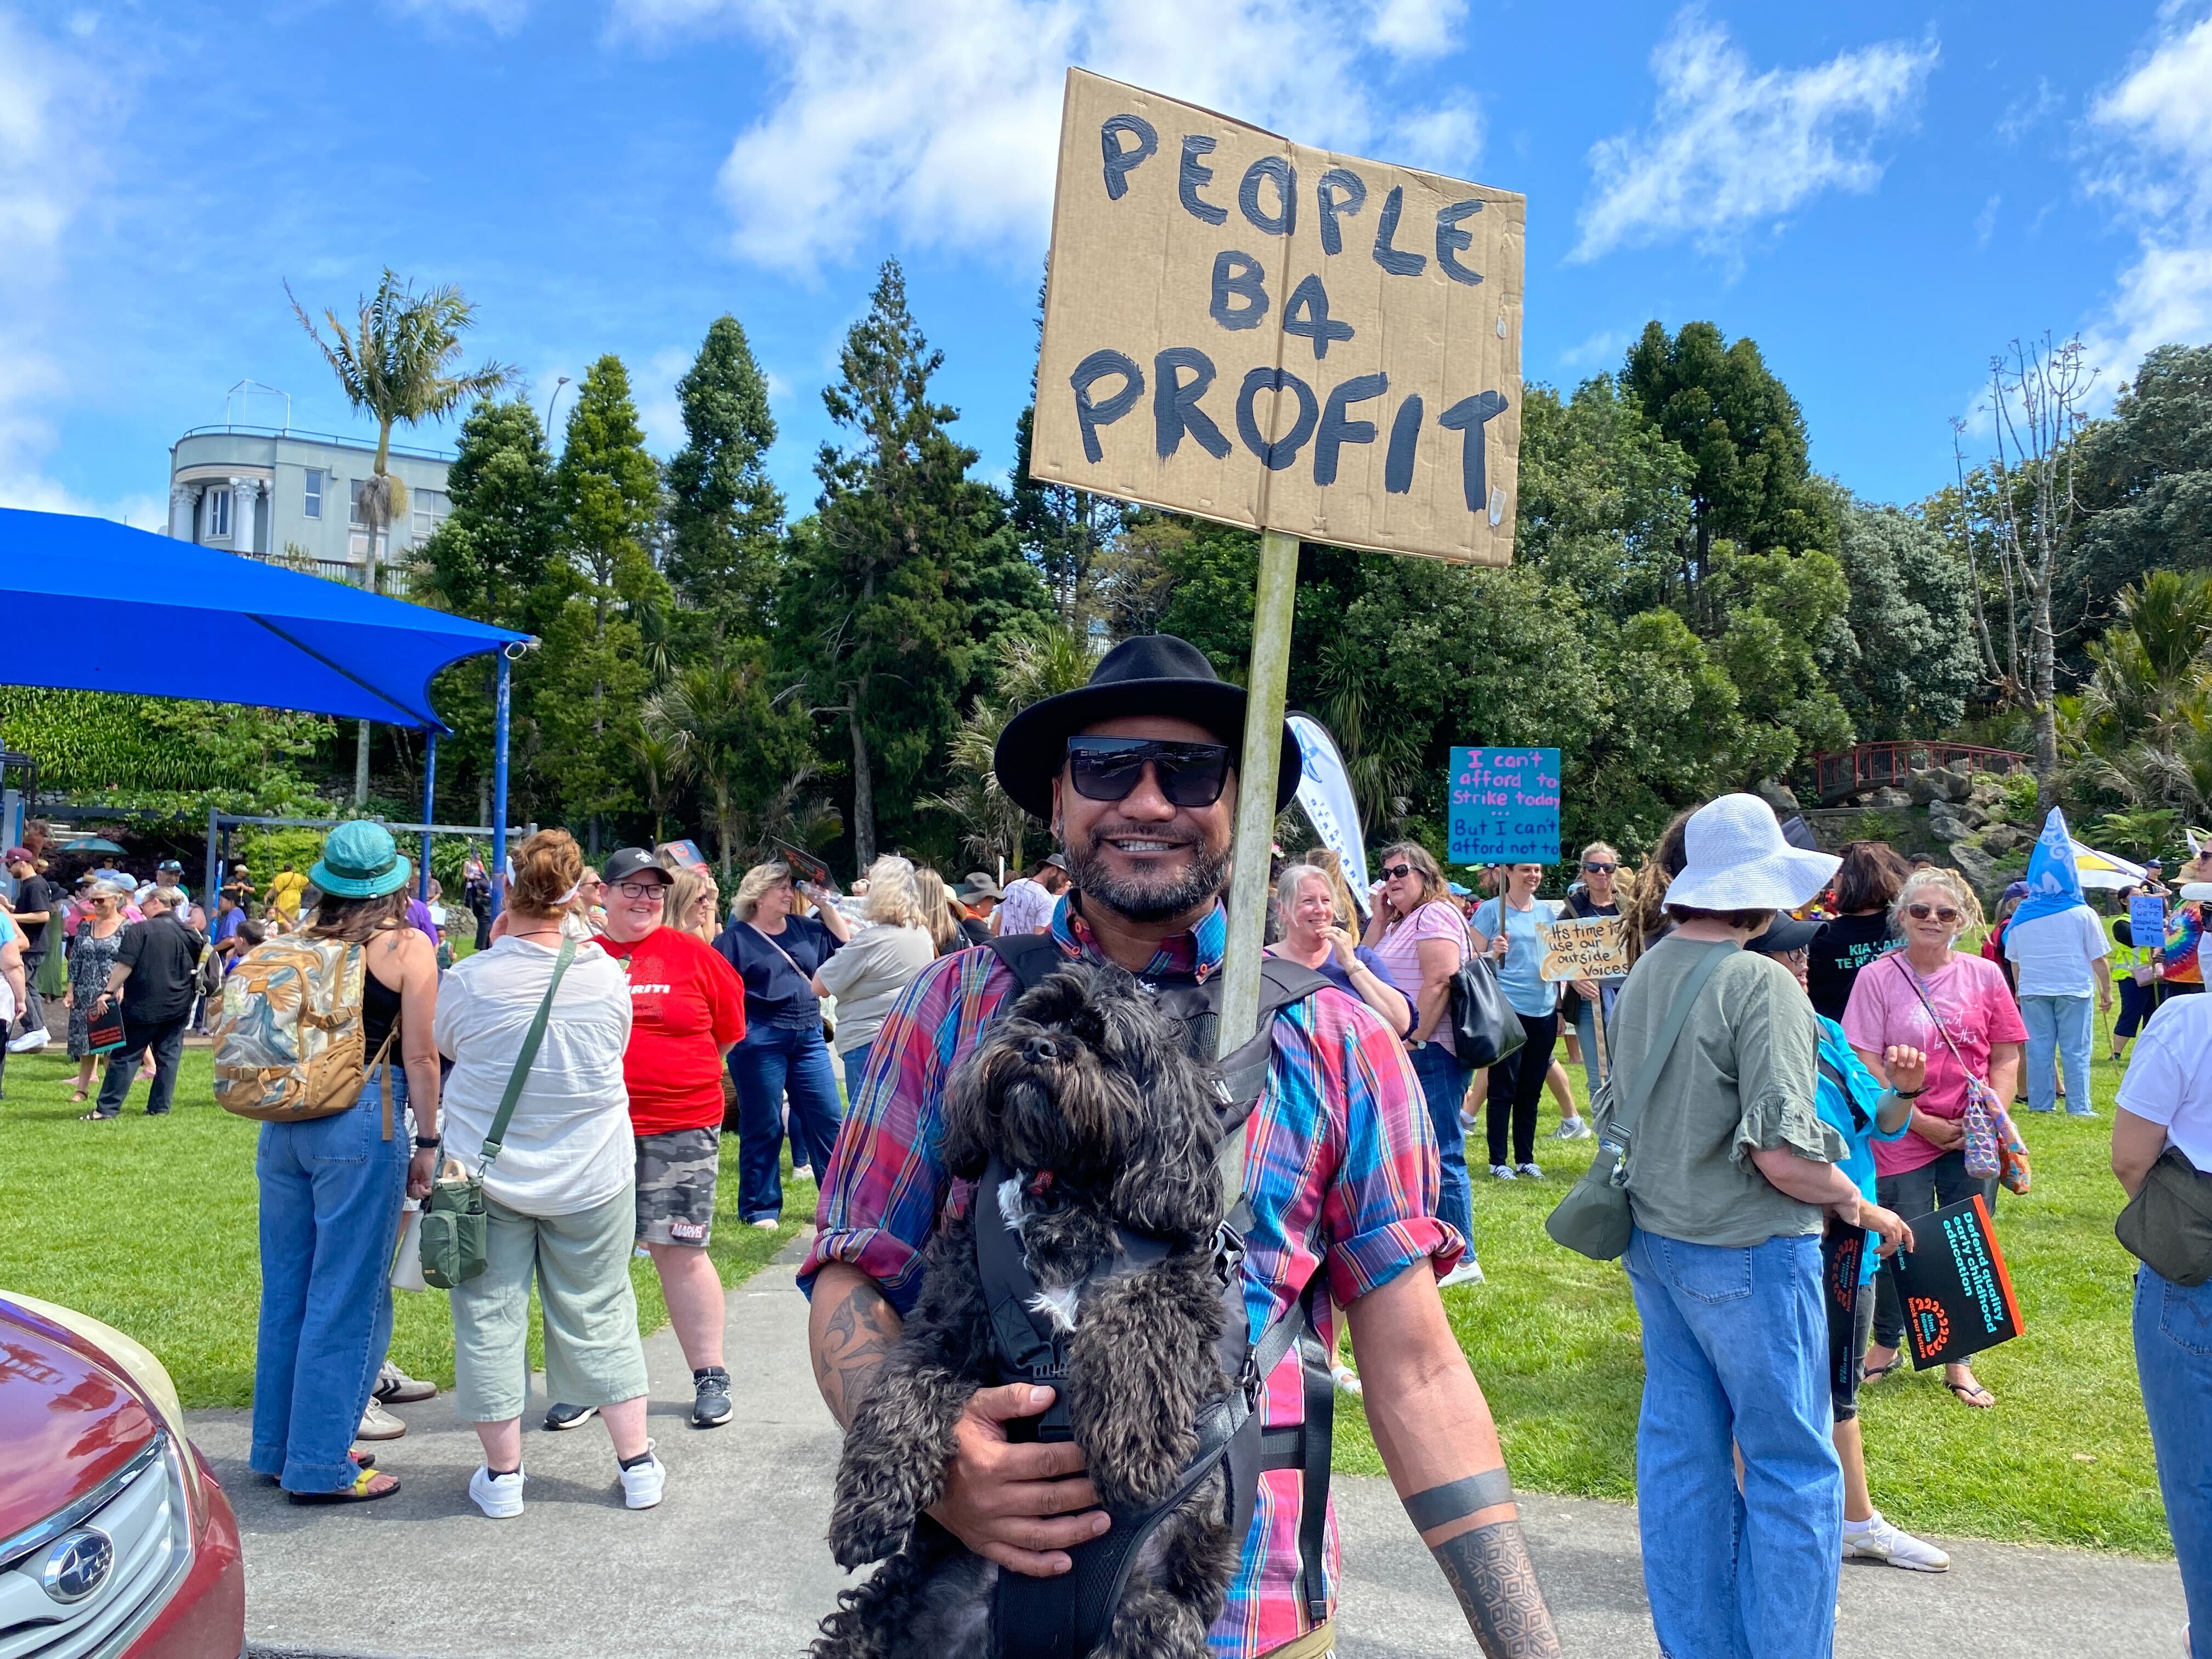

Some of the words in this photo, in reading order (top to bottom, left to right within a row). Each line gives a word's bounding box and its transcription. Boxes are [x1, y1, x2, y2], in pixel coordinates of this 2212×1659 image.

[1101, 113, 1486, 286] PEOPLE
[1210, 250, 1356, 359] B4
[1070, 346, 1509, 513] PROFIT
[1467, 750, 1483, 768] I
[1493, 751, 1543, 768] can't
[1459, 769, 1521, 789] afford
[1536, 772, 1558, 788] to
[1452, 789, 1508, 806] Strike
[1515, 791, 1560, 811] today
[1455, 819, 1487, 836] But
[1495, 821, 1506, 836] I
[1514, 817, 1556, 834] can't
[1452, 838, 1503, 855] afford
[1510, 840, 1537, 854] not
[1542, 843, 1559, 855] to
[2132, 900, 2147, 909] You
[1572, 923, 1604, 938] time
[1549, 941, 1573, 952] use
[1579, 939, 1601, 948] our
[1849, 943, 1871, 956] KIA
[1558, 950, 1611, 964] outside
[1835, 958, 1853, 969] TE
[1943, 1220, 1972, 1297] education
[1963, 1211, 1989, 1267] Defend
[1982, 1268, 2004, 1321] quality
[1953, 1216, 1972, 1254] early
[1967, 1257, 1997, 1333] childhood
[1908, 1297, 1917, 1318] back
[1916, 1333, 1926, 1359] future
[1927, 1313, 1937, 1332] kimi
